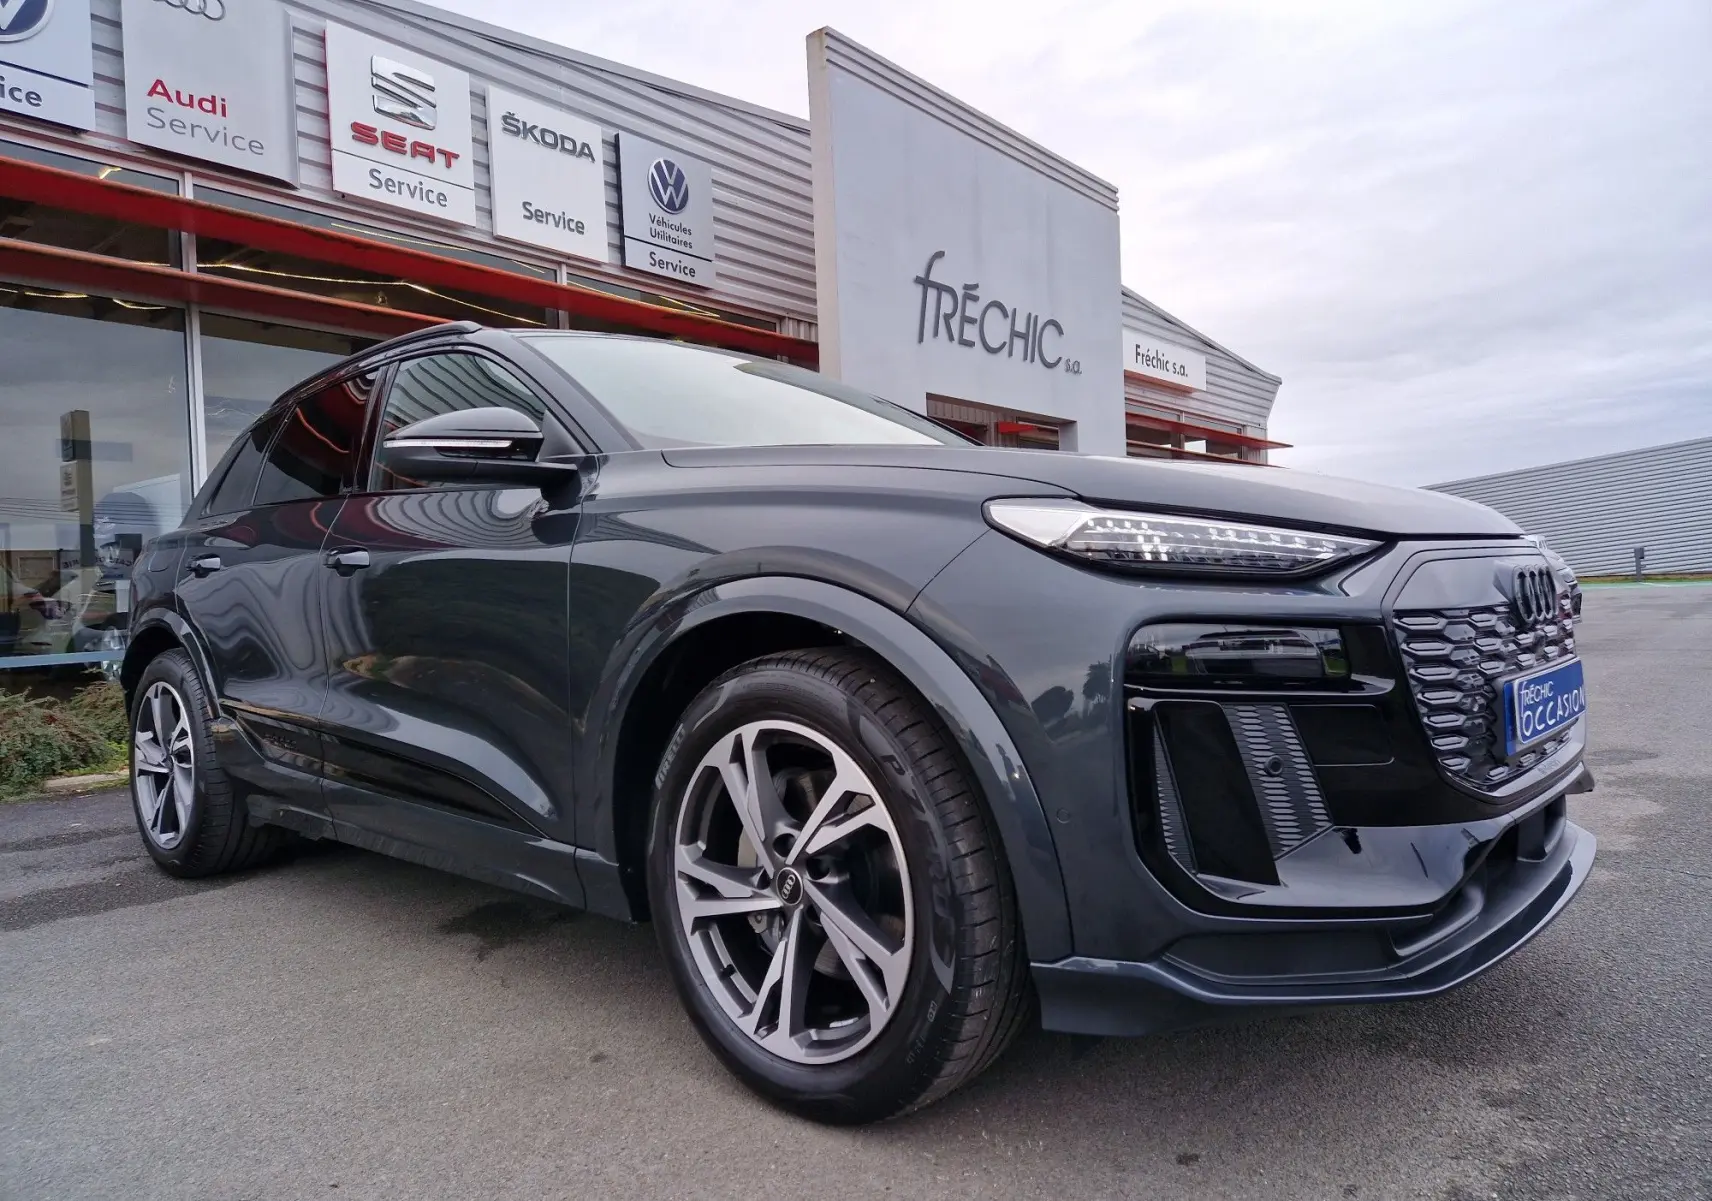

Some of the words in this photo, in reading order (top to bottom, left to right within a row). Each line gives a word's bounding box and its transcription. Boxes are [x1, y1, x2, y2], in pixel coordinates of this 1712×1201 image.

[147, 79, 227, 118] Audi
[147, 107, 264, 155] Service
[351, 121, 460, 169] SEAT
[501, 111, 596, 163] ŠKODA
[368, 168, 448, 207] Service
[522, 201, 585, 235] Service
[649, 212, 692, 236] Véhicules
[650, 227, 693, 249] Utilitaires
[649, 251, 696, 278] Service
[1135, 343, 1170, 373] Fréchic
[1172, 361, 1189, 378] s.a.
[1522, 686, 1585, 737] OCCASION
